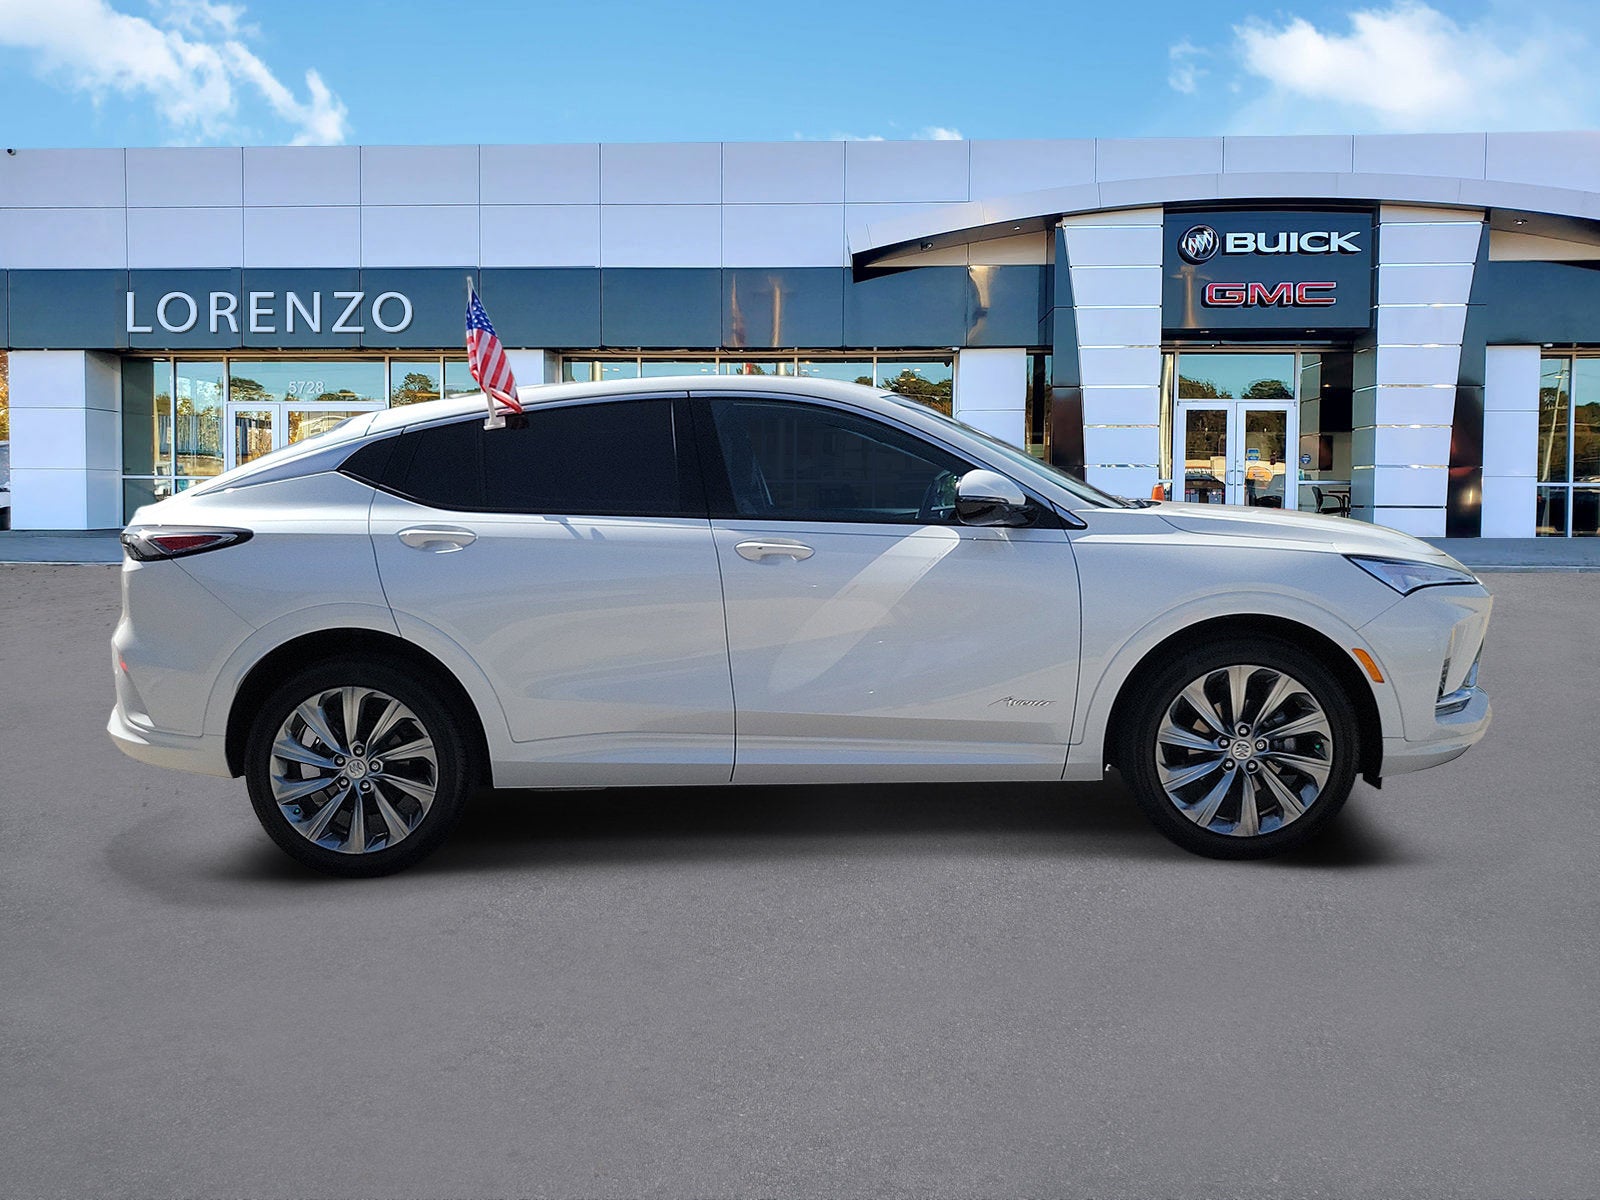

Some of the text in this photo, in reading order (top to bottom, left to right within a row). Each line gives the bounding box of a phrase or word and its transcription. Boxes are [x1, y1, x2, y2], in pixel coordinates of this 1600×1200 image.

[1225, 231, 1362, 253] BUICK
[1206, 282, 1337, 305] GMC
[126, 291, 413, 333] LORENZO
[288, 380, 325, 394] 5728
